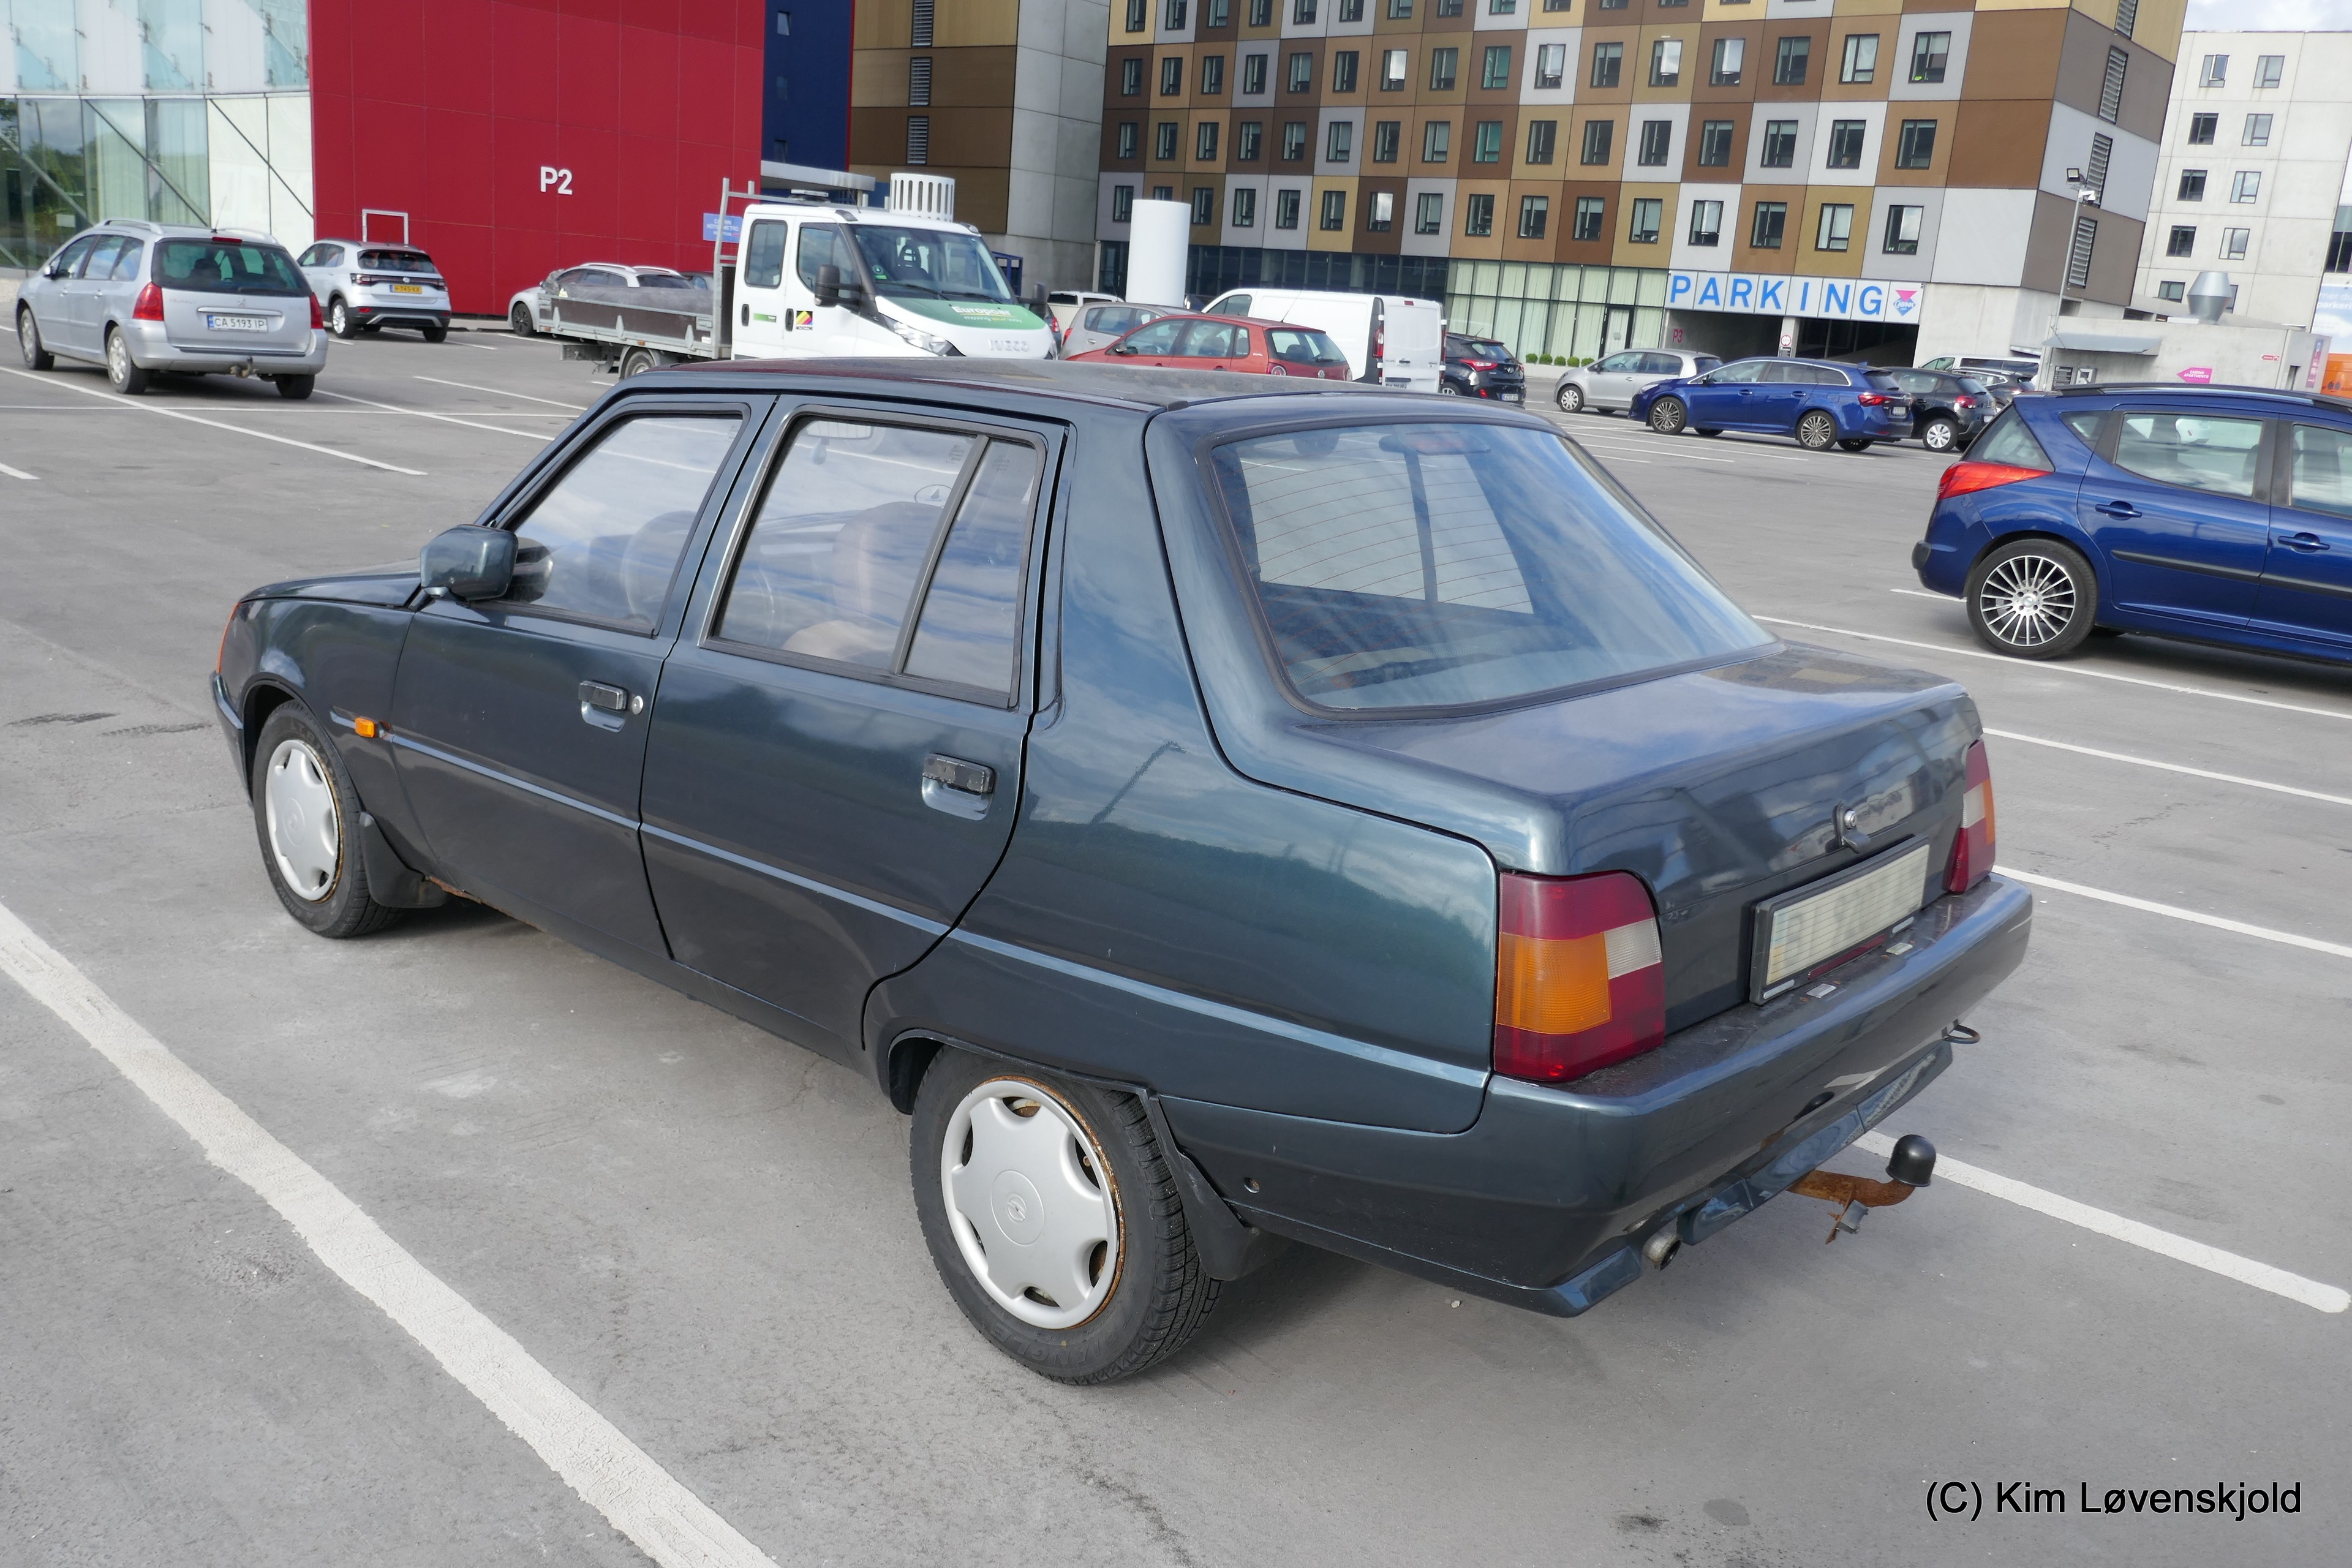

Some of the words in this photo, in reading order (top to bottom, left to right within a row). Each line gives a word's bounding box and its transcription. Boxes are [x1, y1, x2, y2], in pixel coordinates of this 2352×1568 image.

[540, 166, 573, 195] P2
[1670, 275, 1882, 315] PARKING
[952, 306, 1011, 315] Europcar
[214, 318, 228, 328] CA
[230, 318, 252, 328] 5193
[254, 320, 265, 329] IP
[1672, 328, 1683, 343] P3
[988, 338, 1030, 352] IVECO
